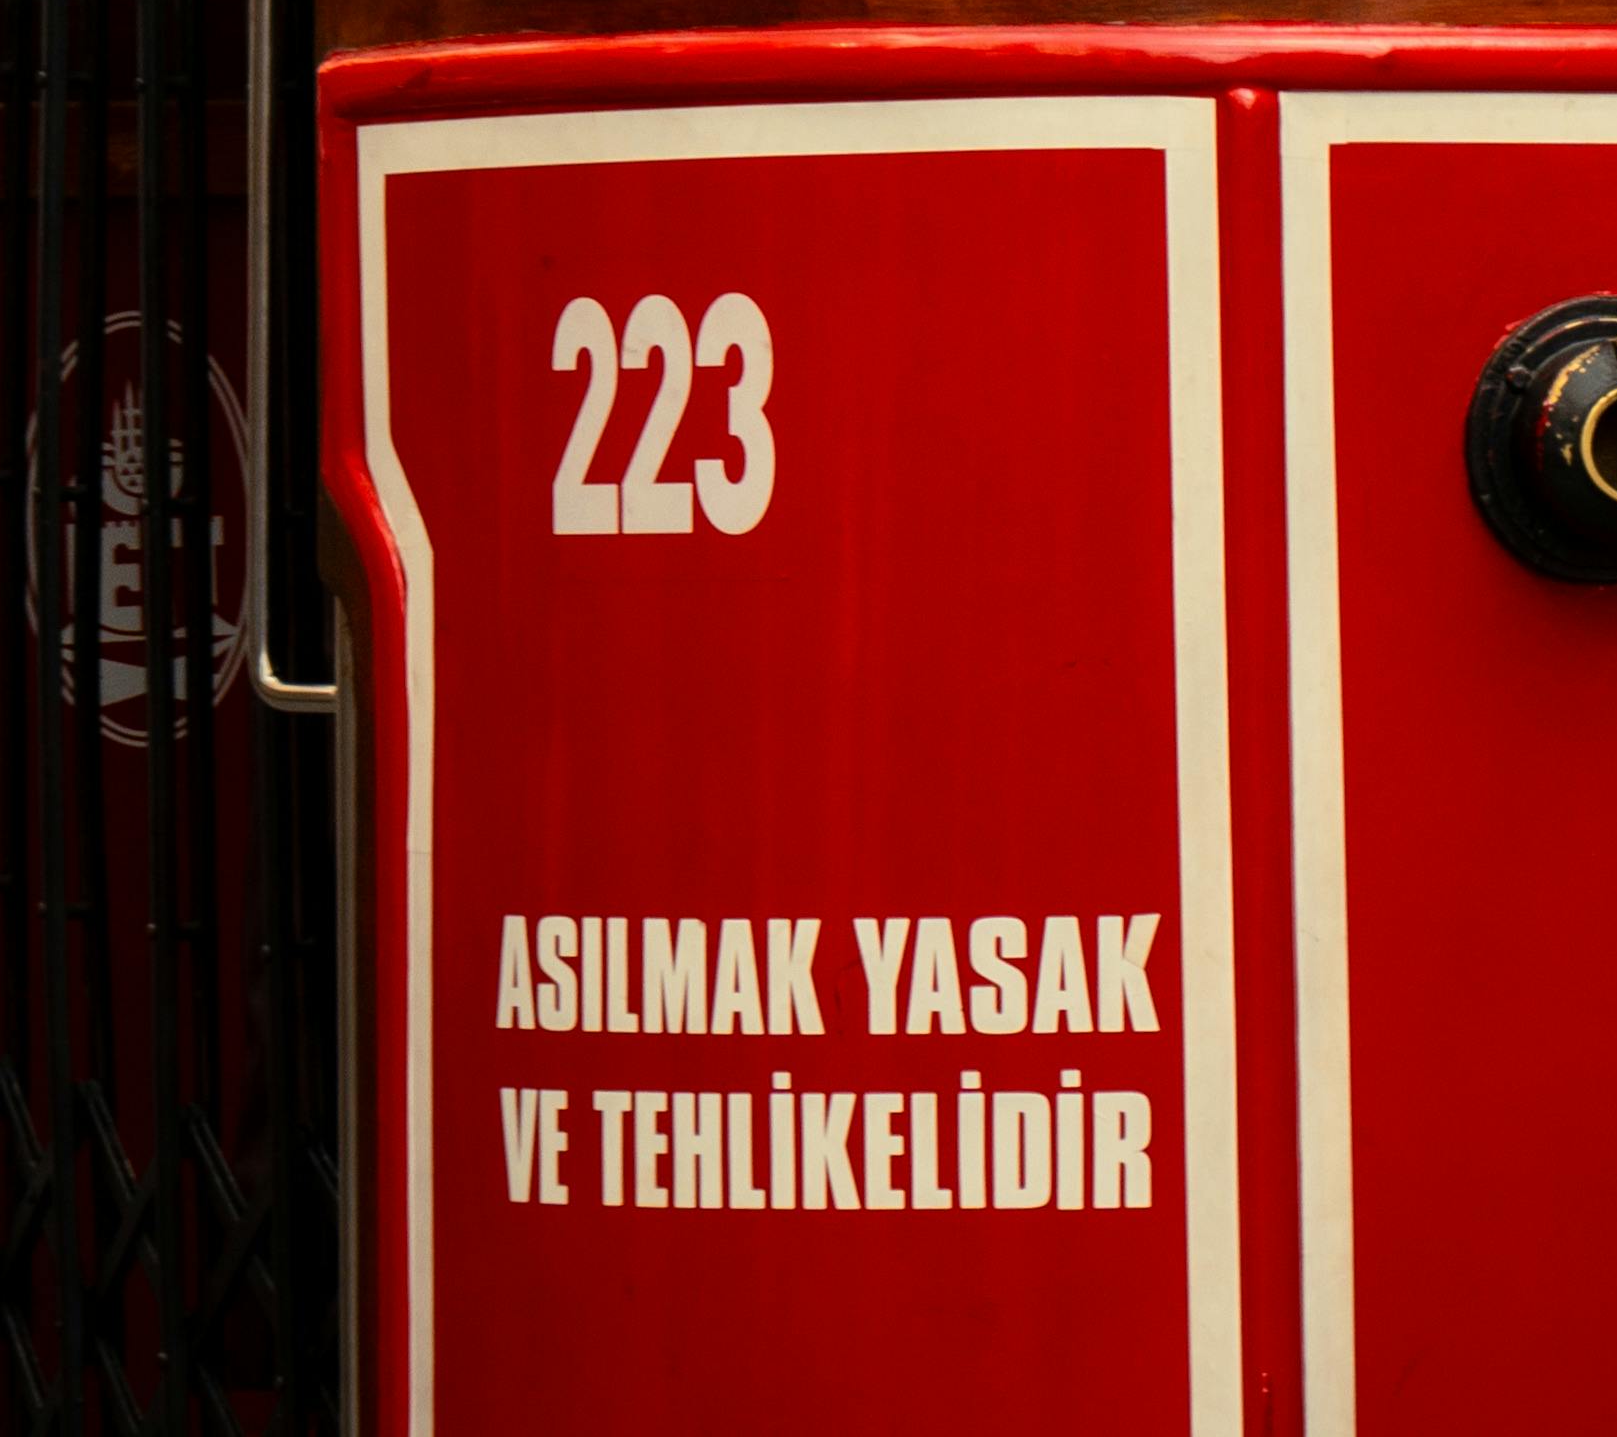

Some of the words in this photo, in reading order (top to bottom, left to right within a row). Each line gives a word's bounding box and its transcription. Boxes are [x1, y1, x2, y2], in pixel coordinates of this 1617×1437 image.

[552, 292, 775, 535] 223
[496, 915, 825, 1035] ASILMAK
[853, 913, 1161, 1035] YASAK
[500, 1088, 569, 1205] VE
[593, 1069, 1153, 1210] TEHLİKELİDİR
